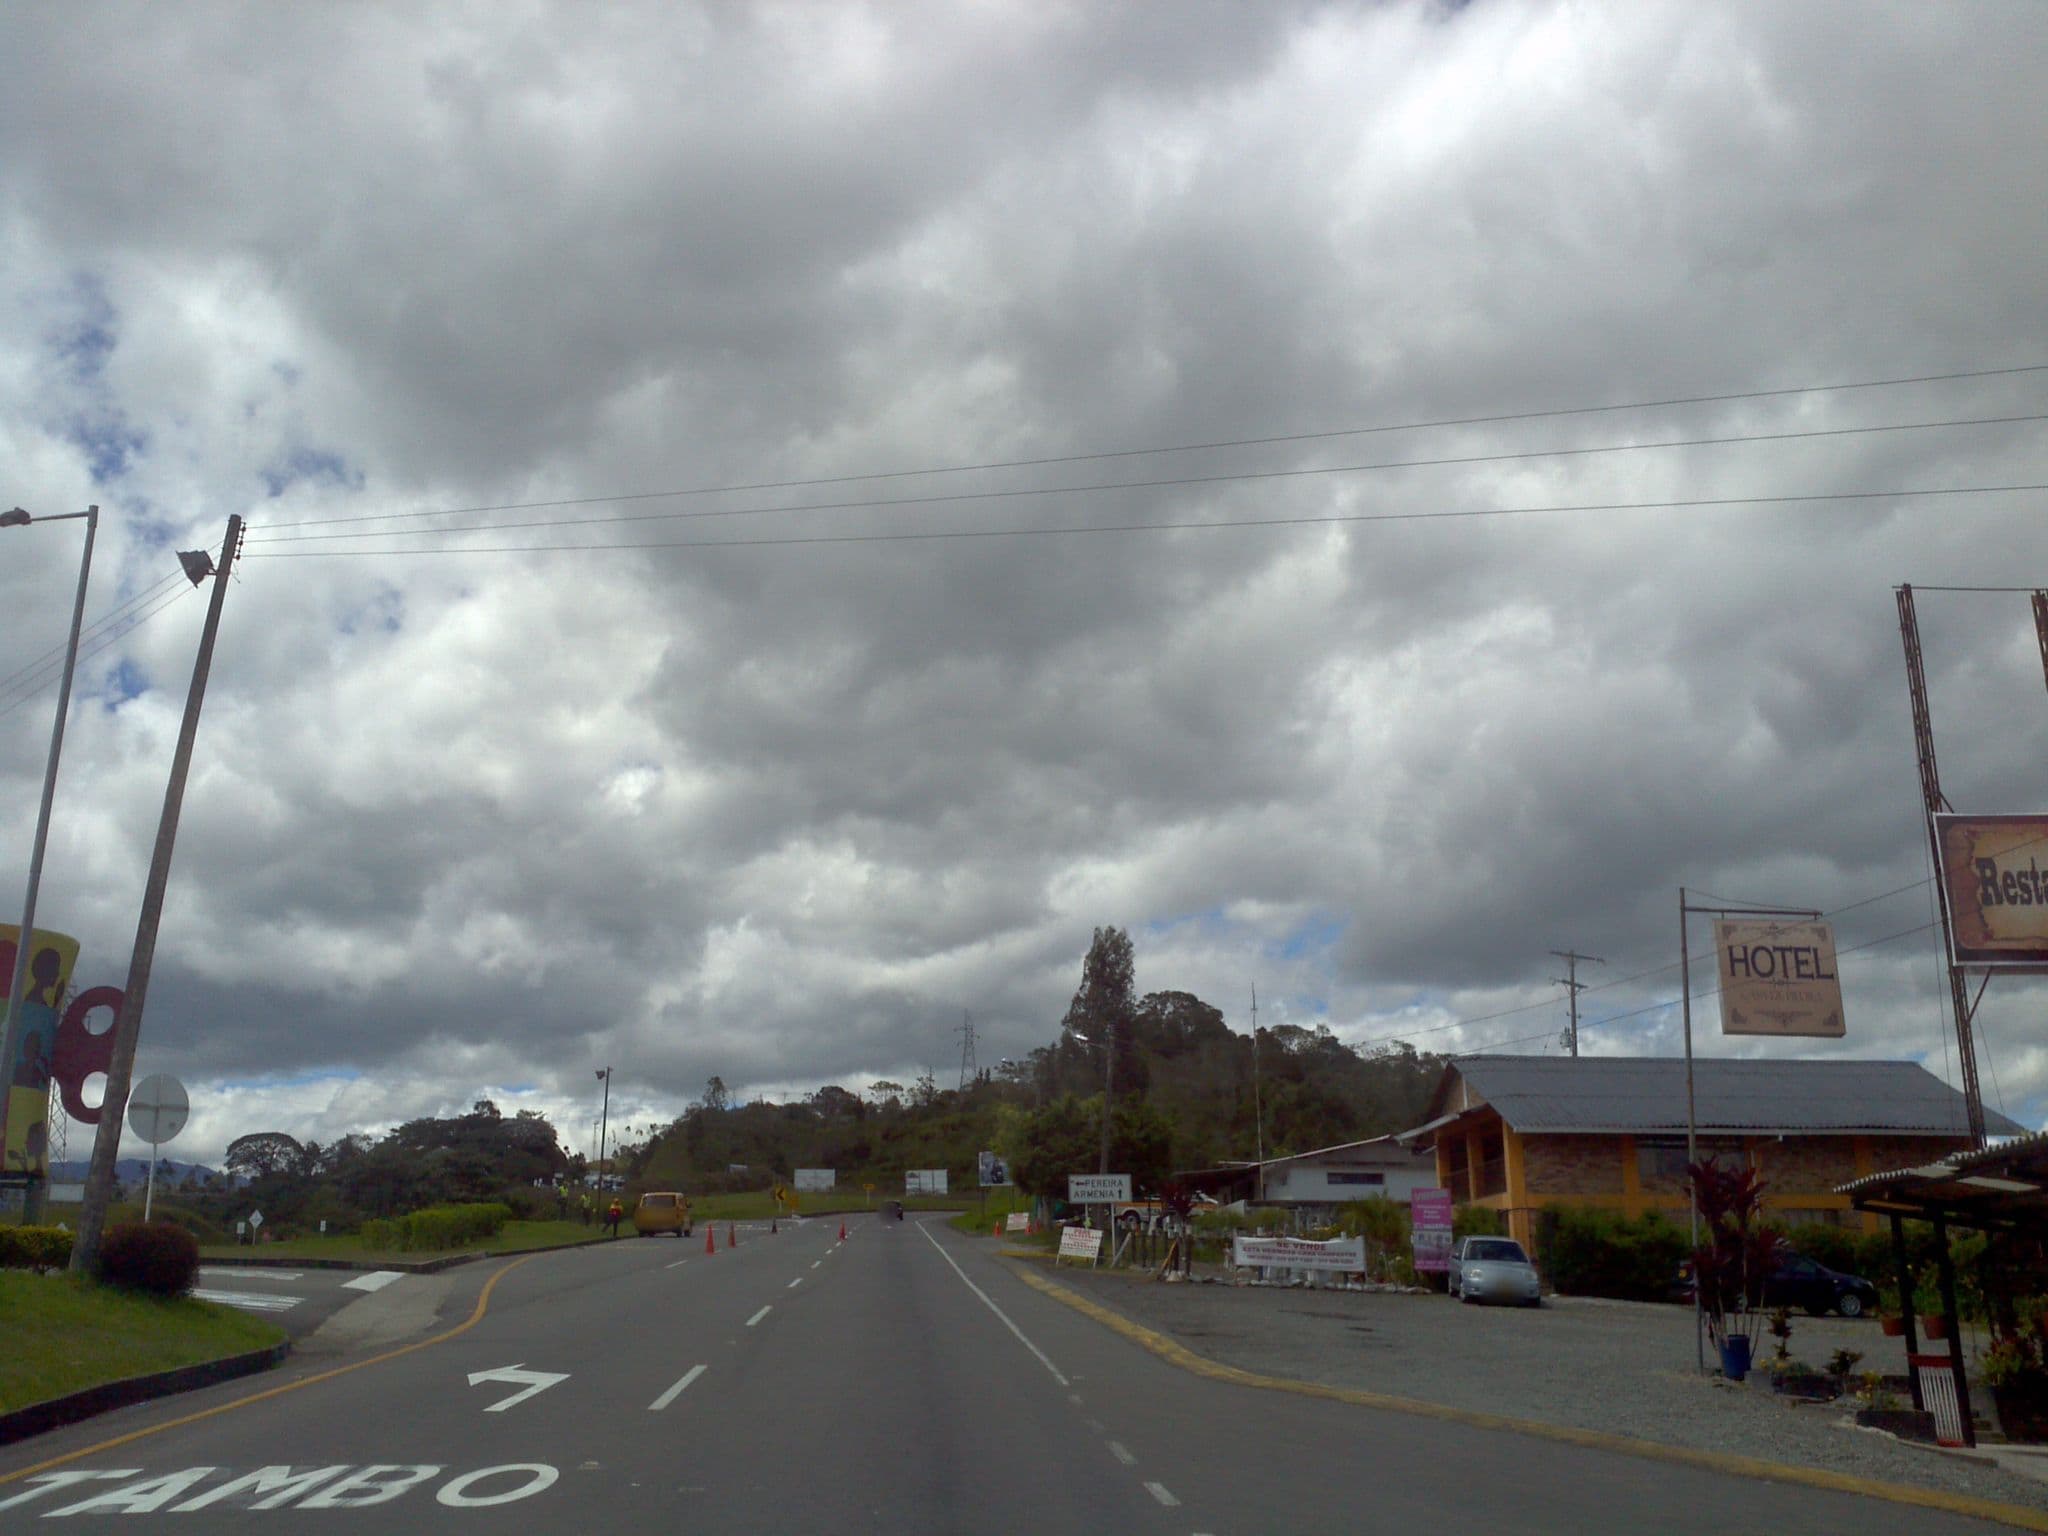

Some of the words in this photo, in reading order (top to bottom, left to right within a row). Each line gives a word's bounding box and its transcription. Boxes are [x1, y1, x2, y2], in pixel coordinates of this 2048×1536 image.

[1728, 945, 1835, 980] HOTEL
[1085, 1179, 1123, 1188] PEREIRA
[1074, 1189, 1114, 1198] ARMENIA
[1292, 1242, 1327, 1251] VENDE
[0, 1464, 560, 1518] TAMBO
